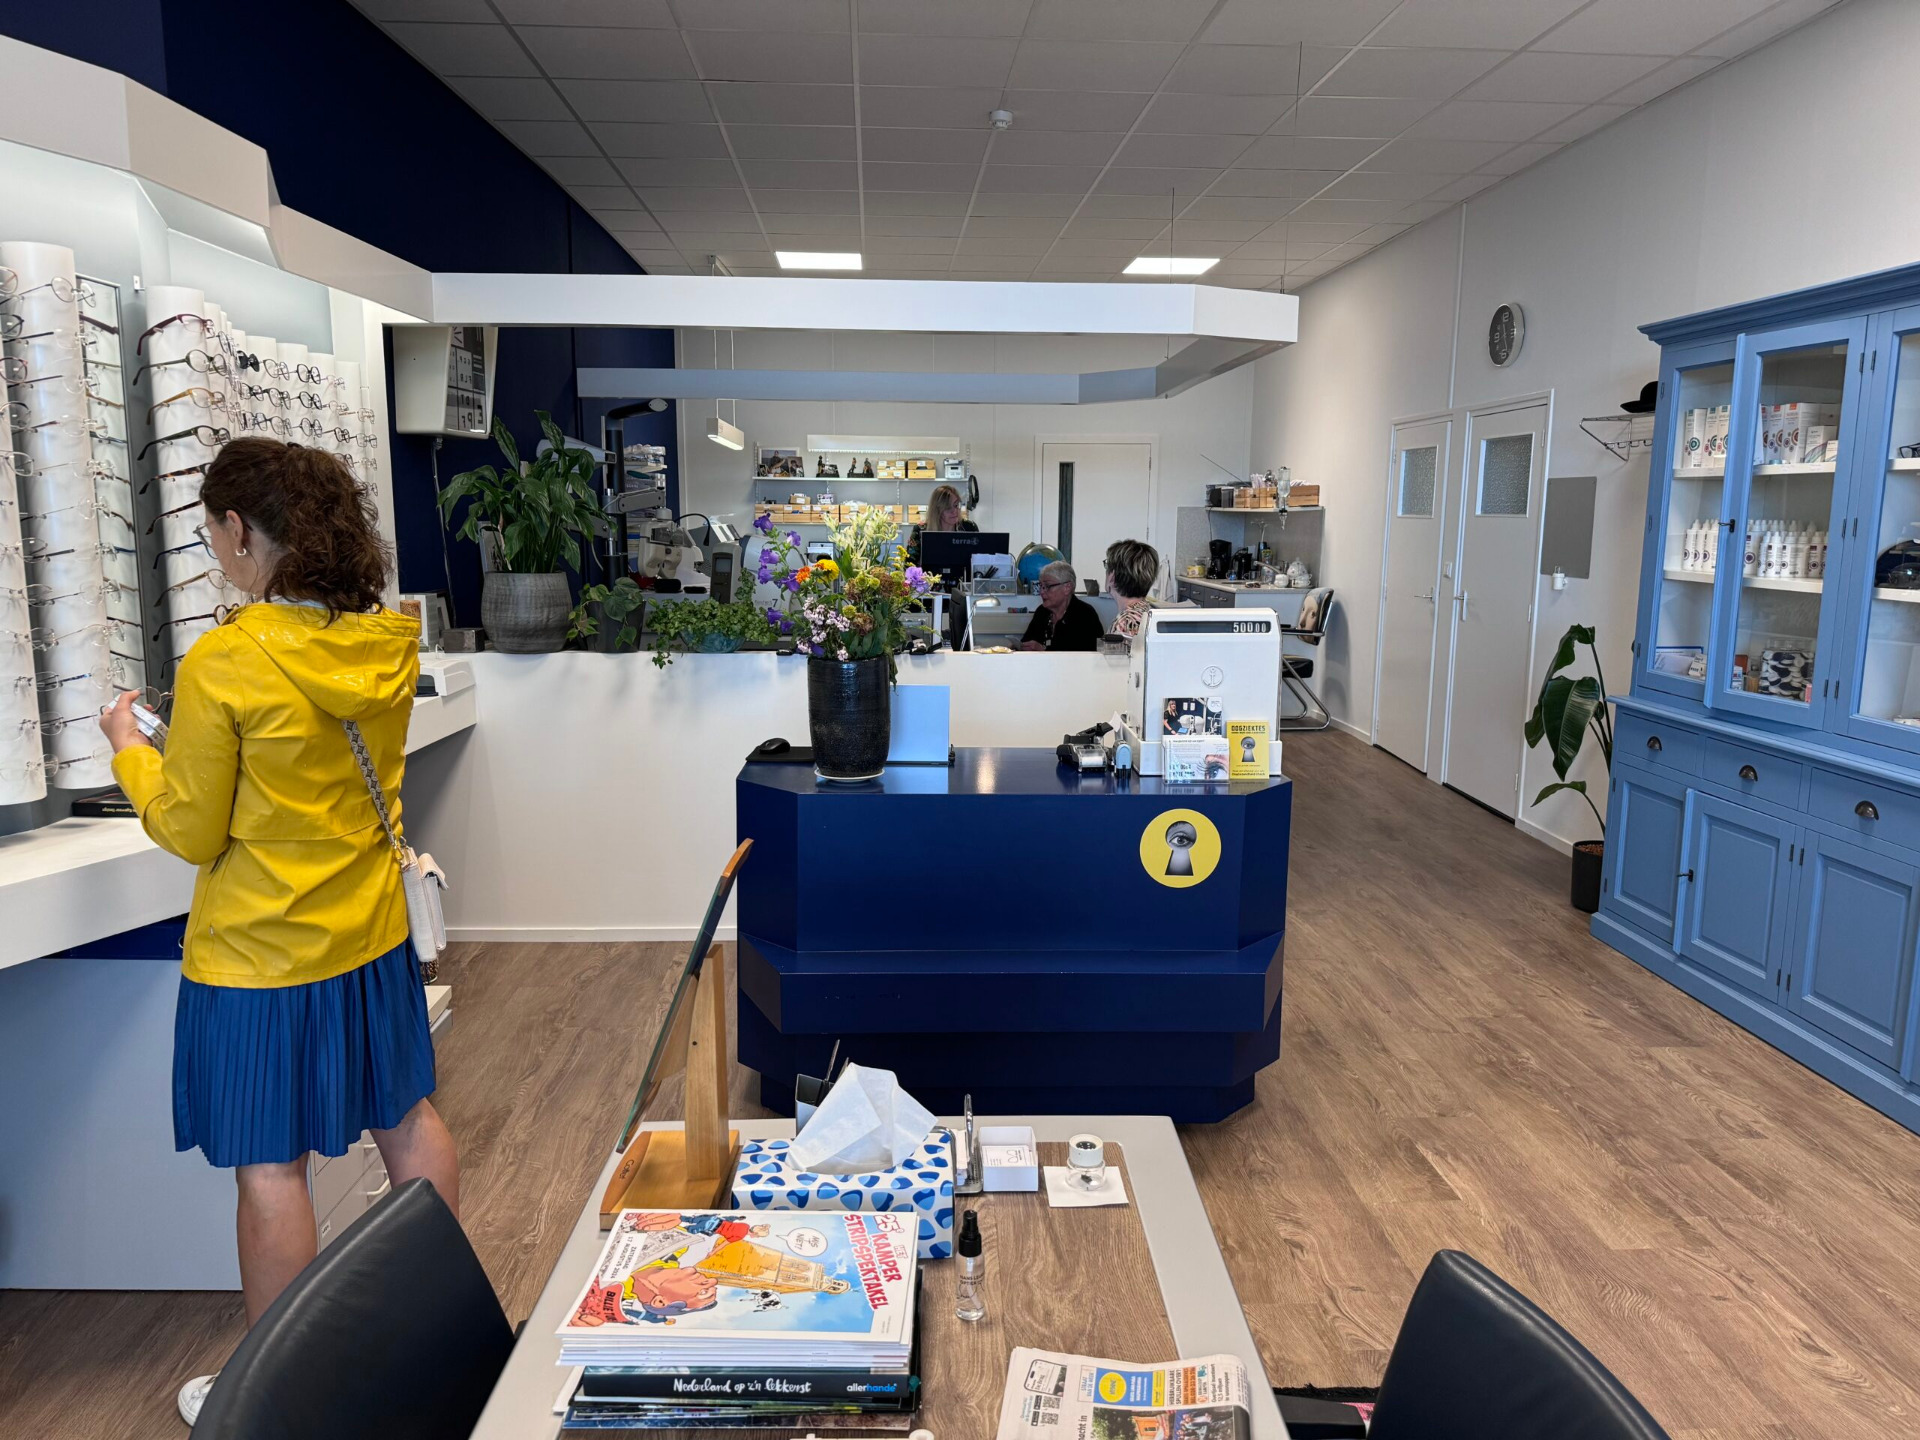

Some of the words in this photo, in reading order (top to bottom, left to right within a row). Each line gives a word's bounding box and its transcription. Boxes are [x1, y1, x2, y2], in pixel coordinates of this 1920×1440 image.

[952, 537, 971, 545] terra
[843, 1213, 889, 1310] STRIPSPEKTAKEL
[871, 1233, 902, 1283] KAMPER
[602, 1290, 616, 1312] BILLIE
[673, 1377, 731, 1392] Nederland
[734, 1382, 745, 1394] op
[846, 1383, 897, 1393] allerhande
